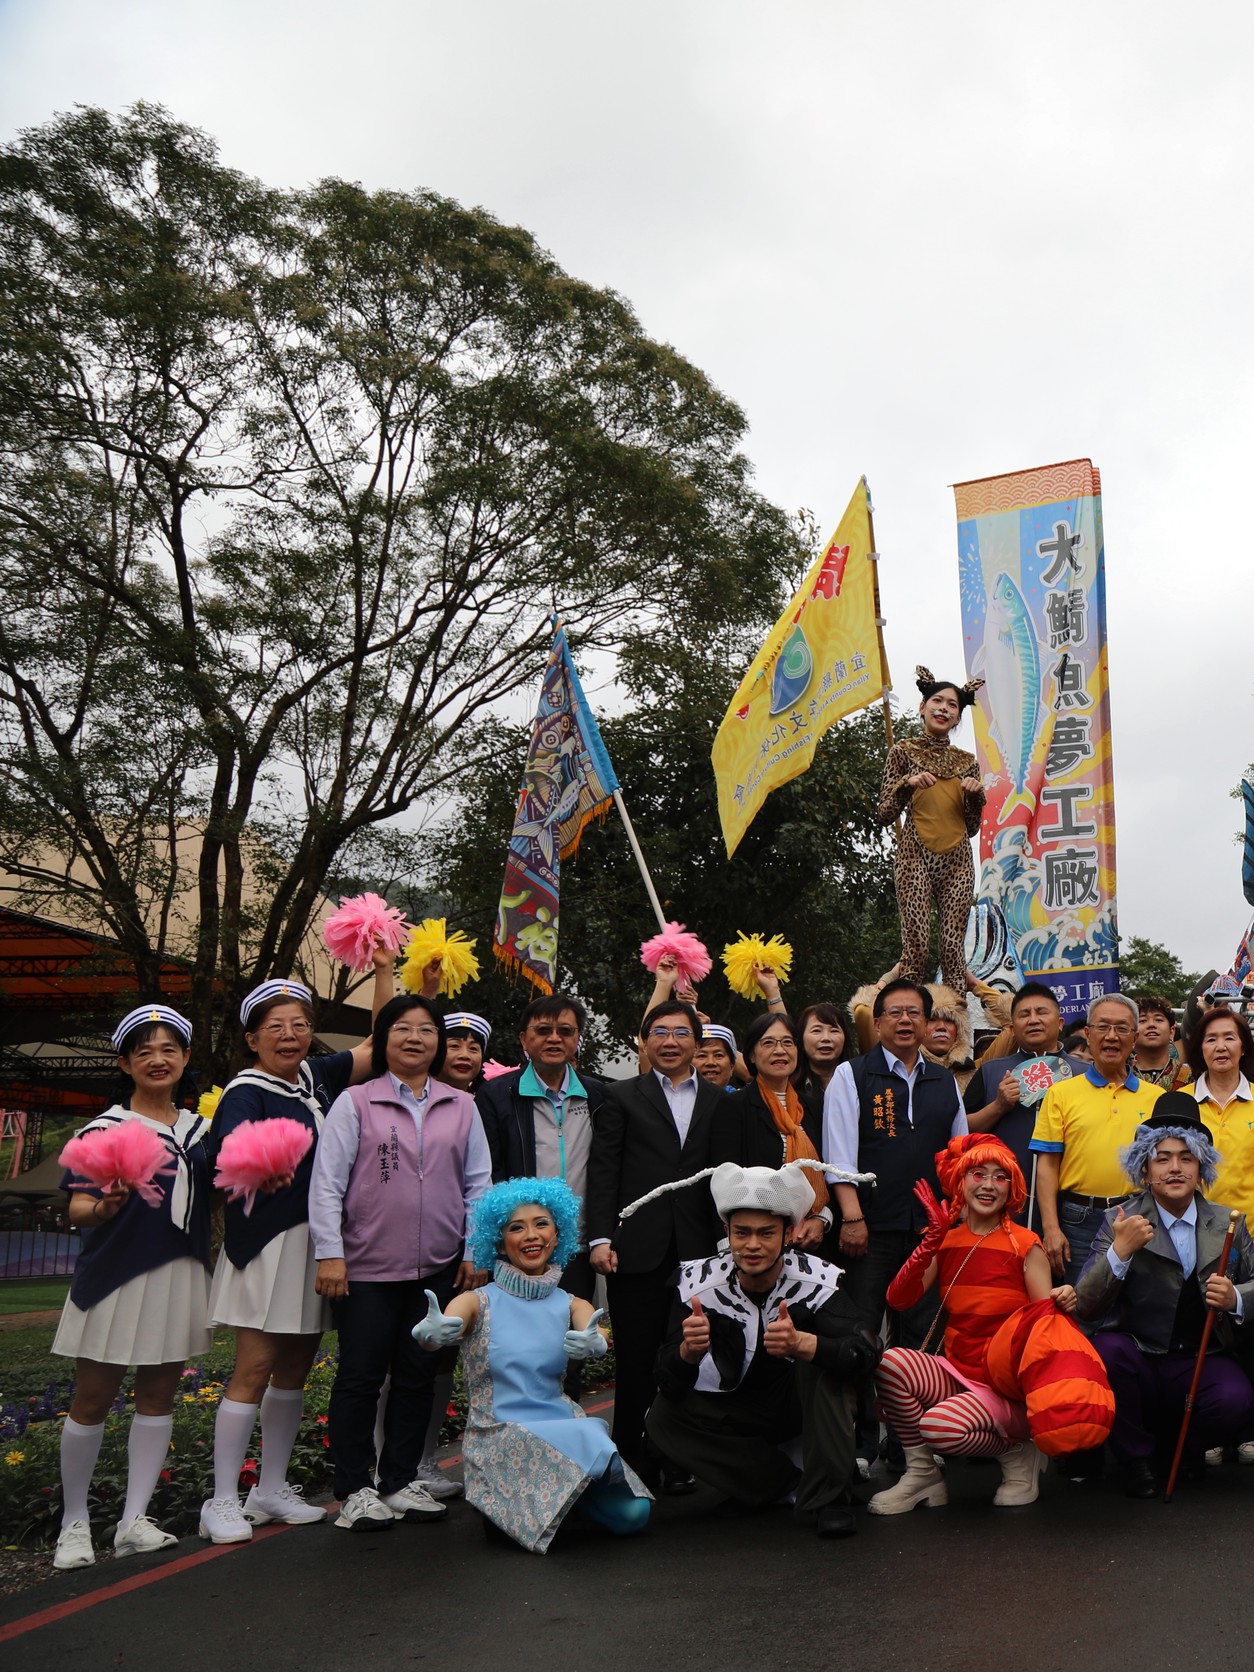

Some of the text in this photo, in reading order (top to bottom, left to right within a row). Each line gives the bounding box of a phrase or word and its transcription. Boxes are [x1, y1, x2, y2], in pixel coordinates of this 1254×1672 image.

[1036, 519, 1101, 914] 大鯖魚夢工廠
[378, 1143, 390, 1184] 陳玉萍
